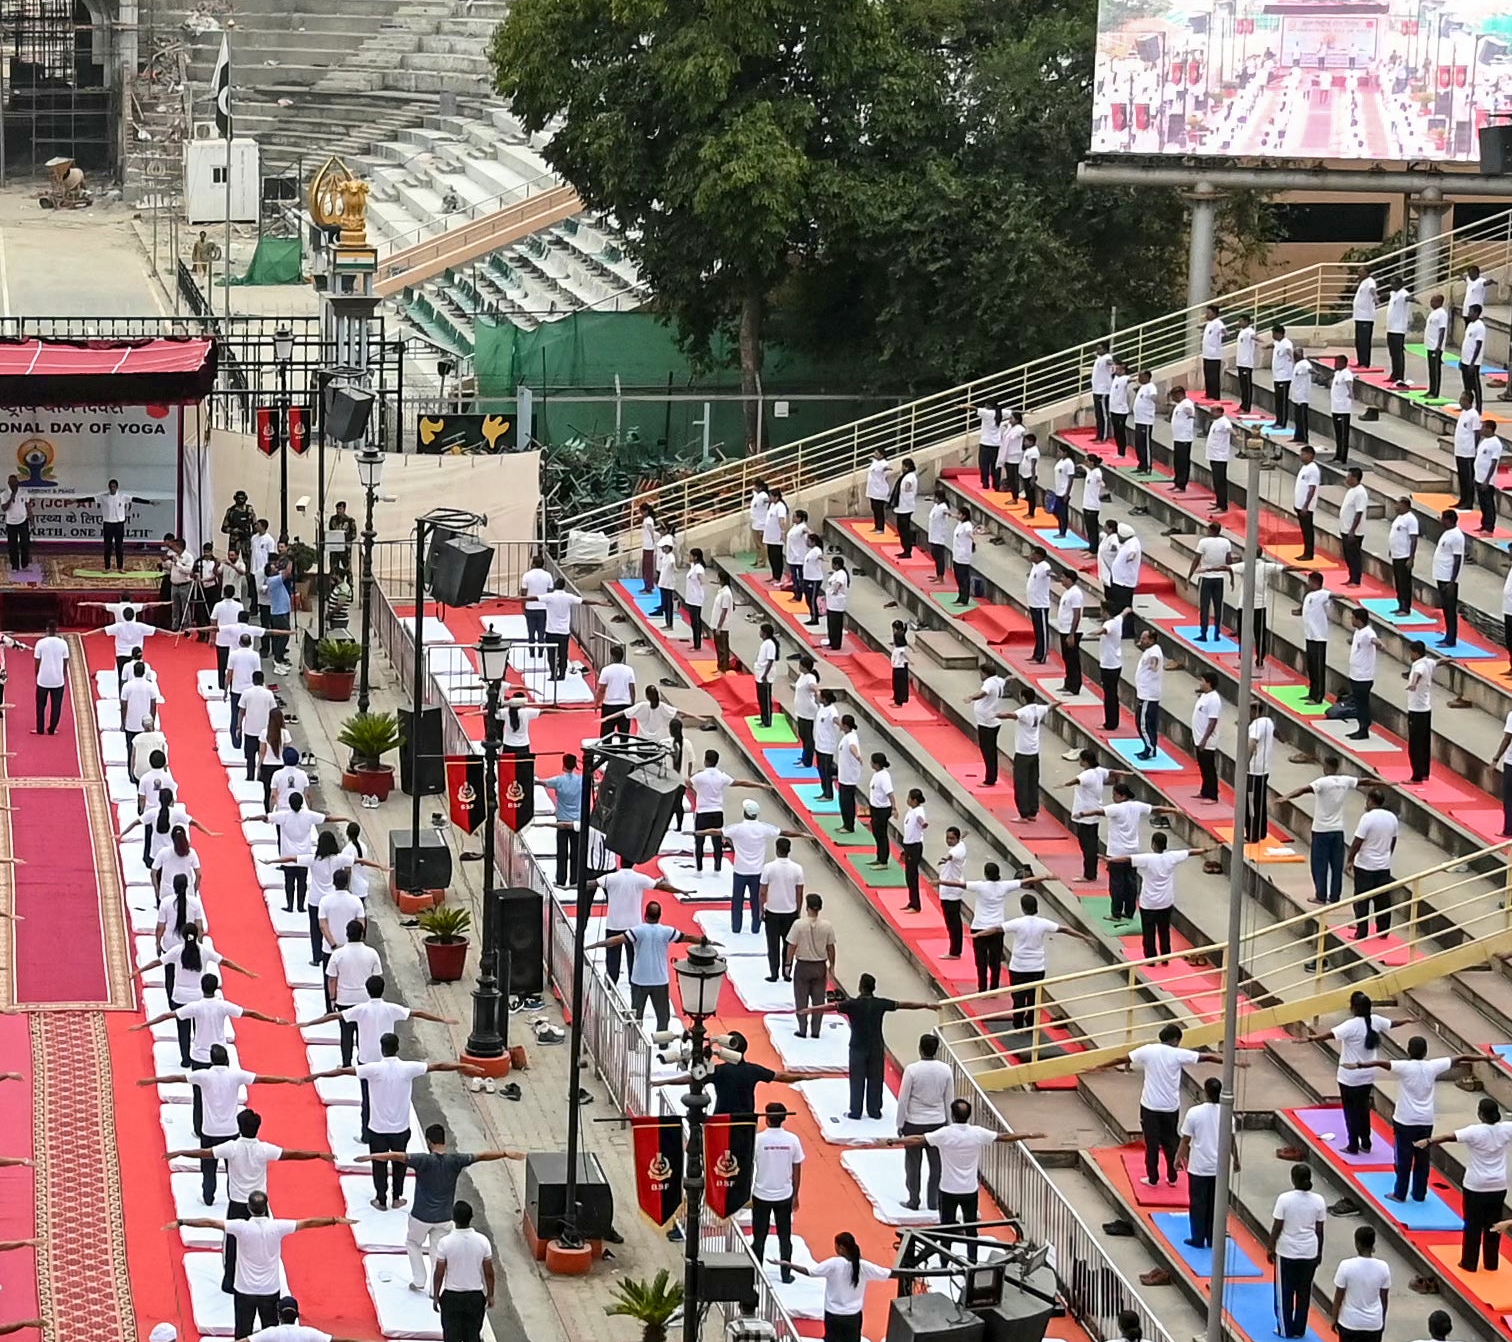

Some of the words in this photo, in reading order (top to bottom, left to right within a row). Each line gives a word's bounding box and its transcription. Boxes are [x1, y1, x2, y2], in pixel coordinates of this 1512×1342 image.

[50, 422, 83, 434] DAY
[89, 423, 112, 434] OF
[118, 423, 166, 435] YOGA
[29, 528, 66, 538] ARTH,
[70, 528, 96, 537] ONE
